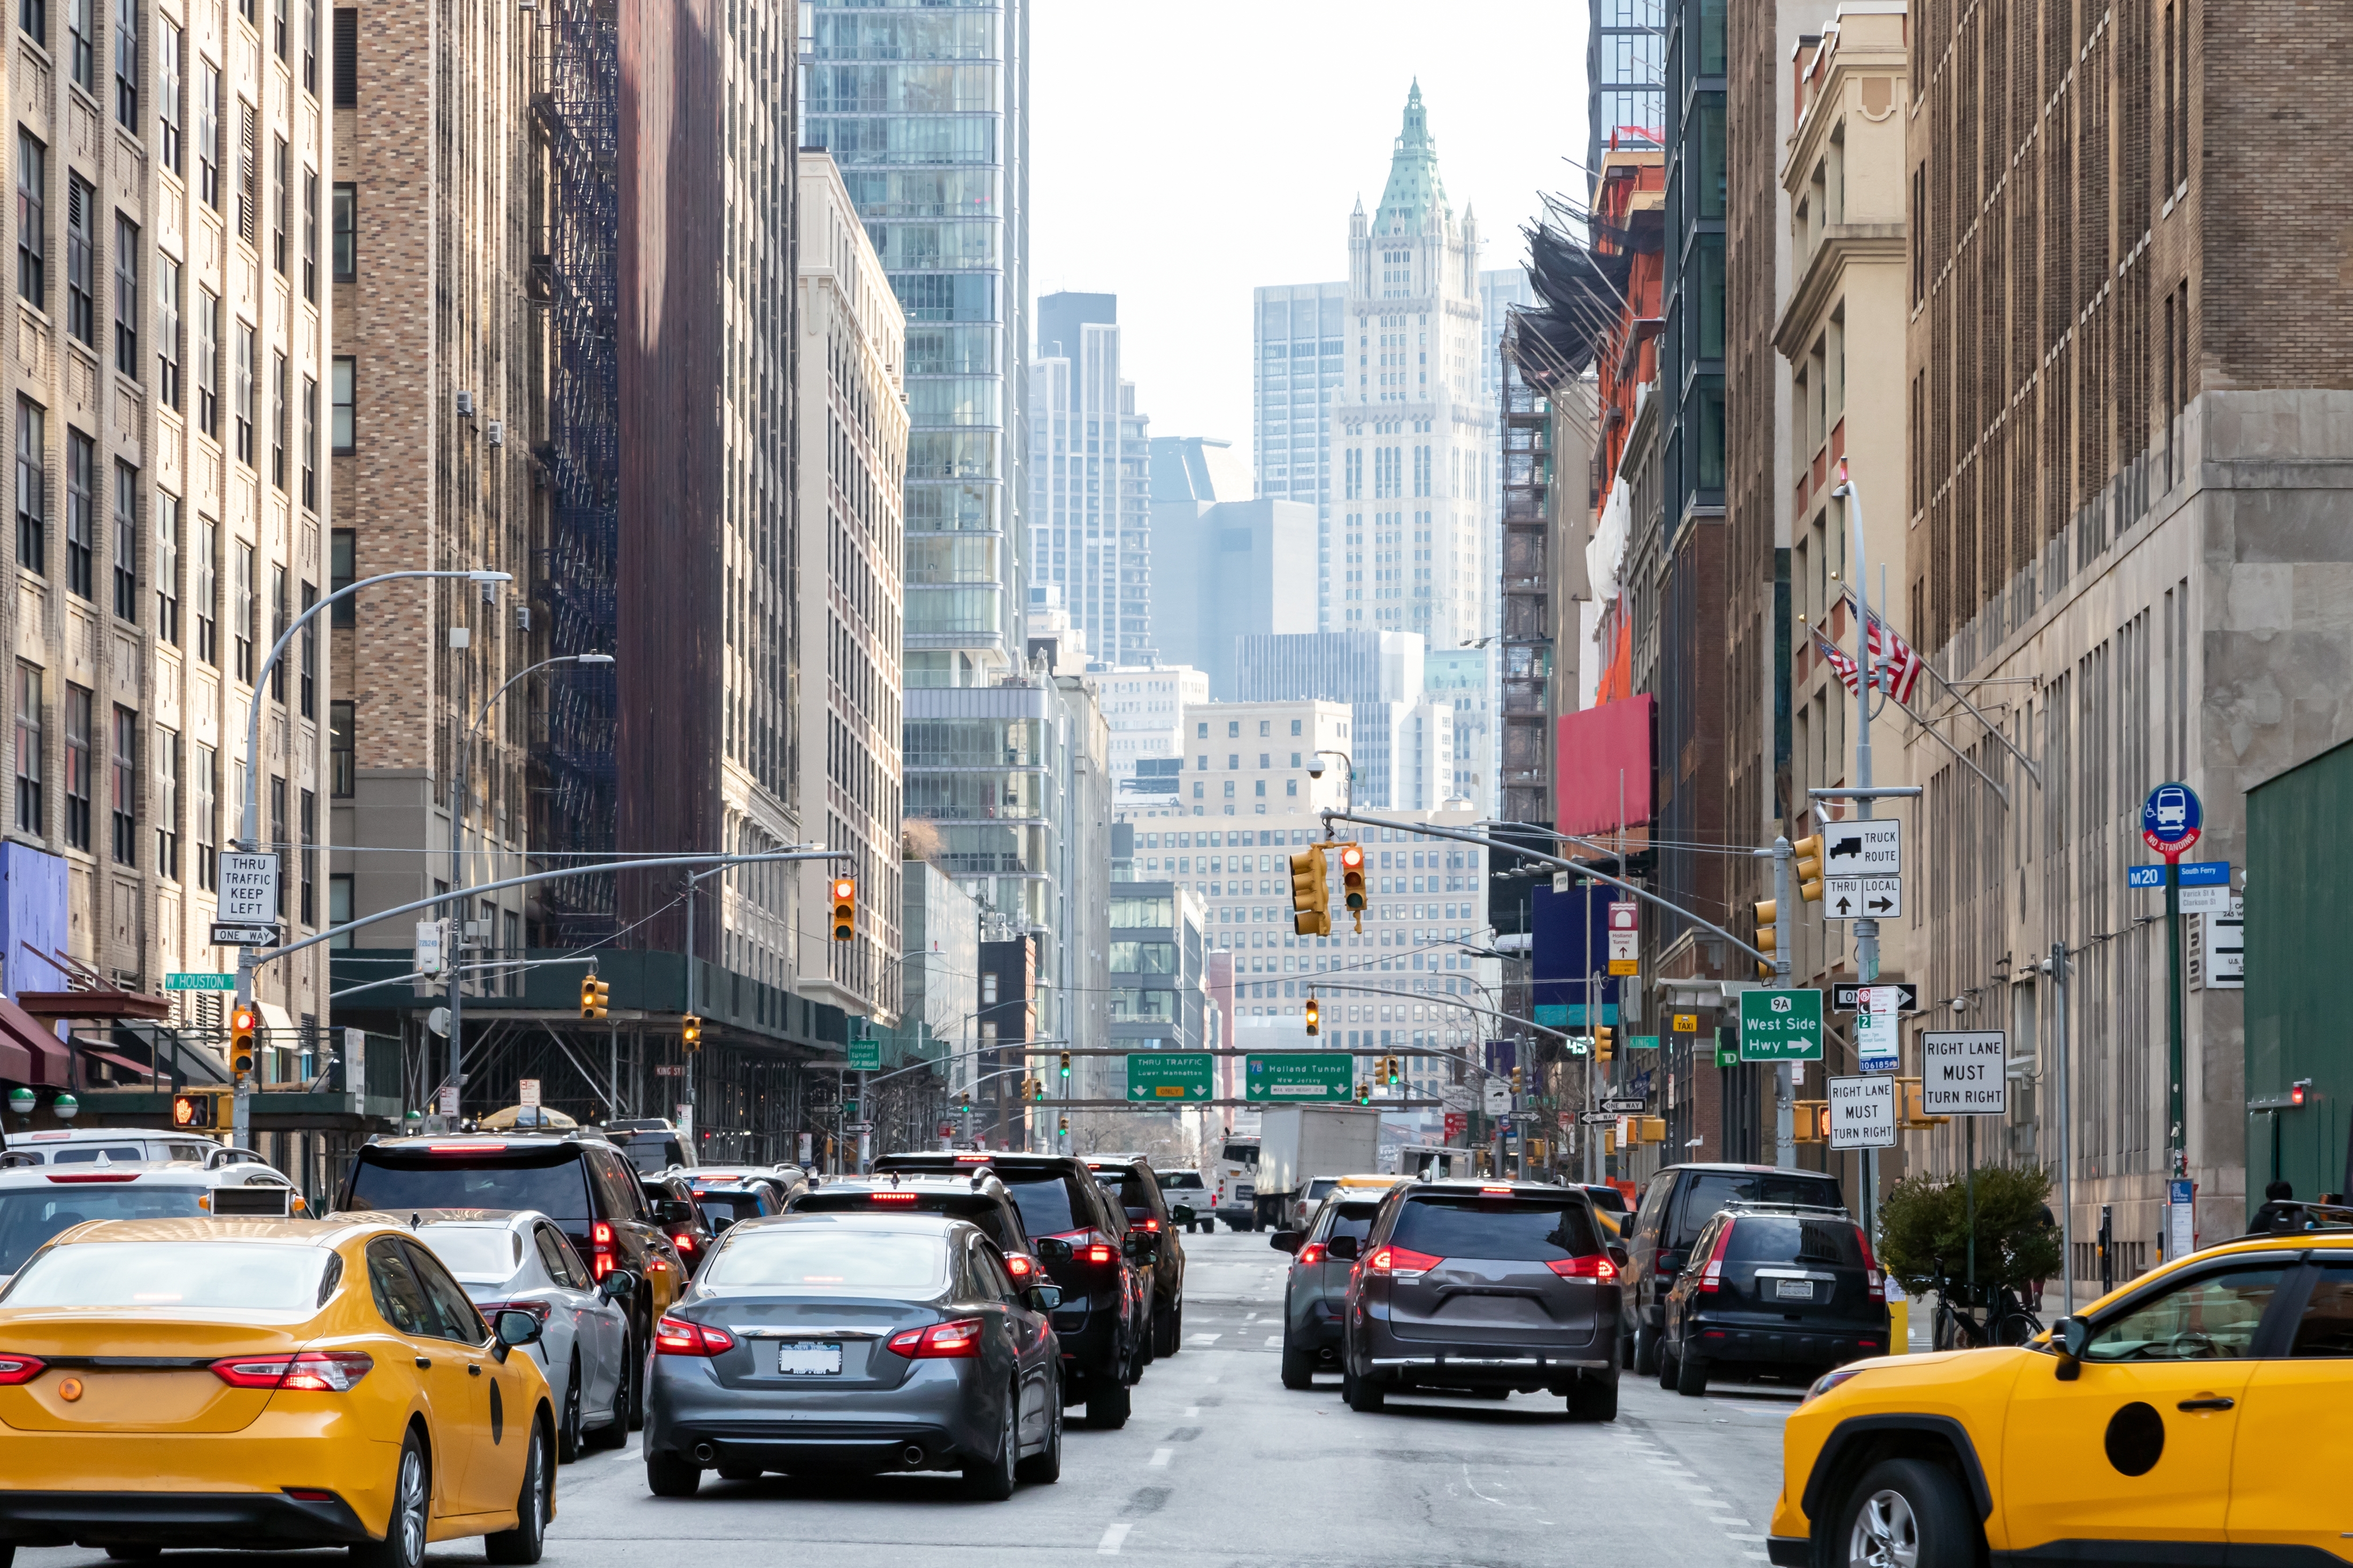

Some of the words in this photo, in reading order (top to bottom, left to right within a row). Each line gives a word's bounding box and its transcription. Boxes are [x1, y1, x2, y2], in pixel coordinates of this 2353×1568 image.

[1865, 832, 1896, 843] TRUCK
[2147, 834, 2158, 847] NO
[2159, 833, 2195, 851] STANDING
[1865, 851, 1896, 862] ROUTE
[232, 858, 266, 870] THRU
[2201, 867, 2216, 875] Ferry
[226, 873, 271, 885] TRAFFIC
[2131, 869, 2158, 885] M20
[1832, 882, 1857, 892] THRU
[1866, 880, 1897, 891] LOCAL
[231, 888, 263, 899] KEEP
[230, 902, 263, 914] LEFT
[220, 931, 240, 940] ONE
[249, 932, 270, 941] WAY
[167, 975, 175, 987] W
[179, 975, 224, 988] HOUSTON
[1846, 992, 1858, 1002] ON
[1773, 999, 1789, 1010] 9A
[1678, 1022, 1693, 1030] TAXI
[1747, 1018, 1781, 1030] West
[1786, 1018, 1816, 1030] Side
[1862, 1016, 1868, 1028] 2
[1631, 1038, 1649, 1047] KING
[1749, 1039, 1781, 1053] Hwy
[1928, 1042, 1964, 1055] RIGHT
[1970, 1042, 2001, 1055] LANE
[1722, 1053, 1737, 1063] TD
[1251, 1064, 1263, 1072] 78
[1861, 1061, 1889, 1069] 106185
[657, 1067, 671, 1075] KING
[674, 1067, 680, 1076] ST
[1943, 1065, 1985, 1080] MUST
[1833, 1086, 1861, 1098] RIGHT
[1865, 1084, 1890, 1096] LANE
[1927, 1091, 1959, 1103] TURN
[1965, 1091, 2002, 1103] RIGHT
[1846, 1104, 1878, 1119] MUST
[1833, 1128, 1859, 1139] TURN
[1863, 1126, 1891, 1138] RIGHT
